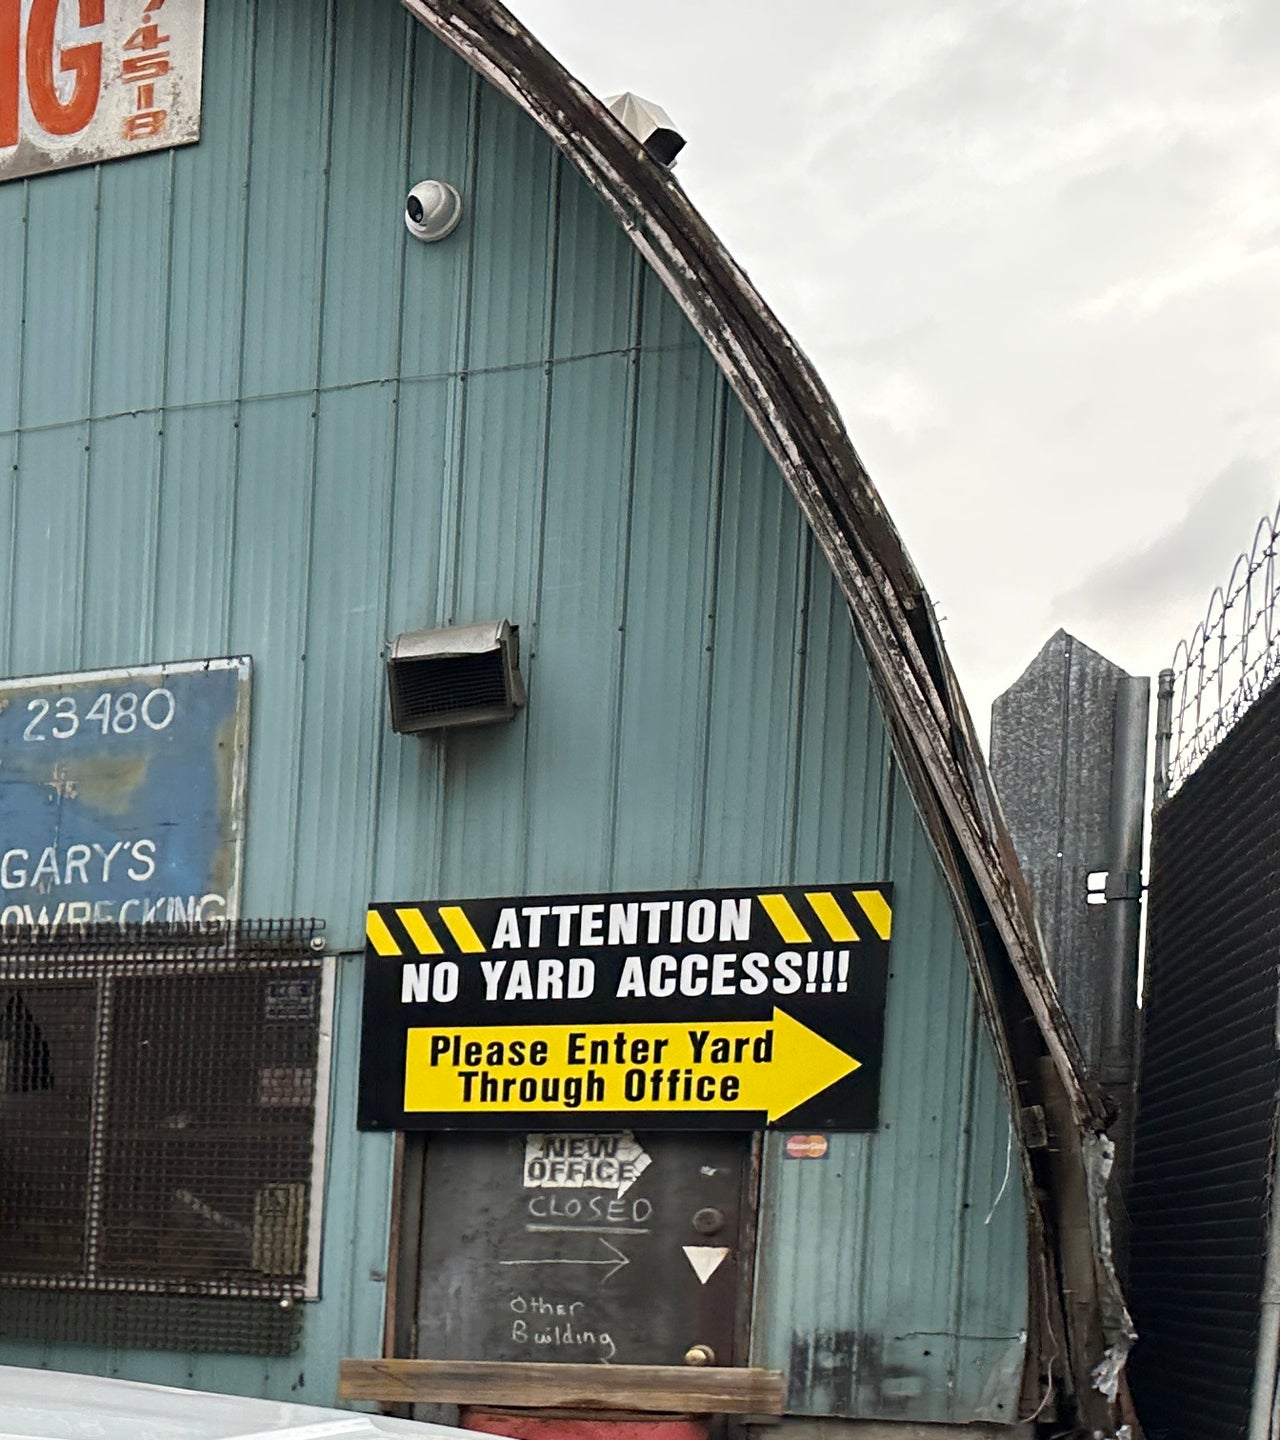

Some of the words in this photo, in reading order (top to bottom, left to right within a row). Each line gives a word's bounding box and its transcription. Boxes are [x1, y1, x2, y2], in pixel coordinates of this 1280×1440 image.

[22, 687, 176, 742] 23480
[0, 839, 157, 890] GARY'S
[491, 897, 752, 949] ATTENTION
[401, 961, 459, 1004] NO
[481, 958, 595, 1001] YARD
[616, 950, 851, 999] ACCESS!!!
[430, 1034, 549, 1068] Please
[567, 1031, 669, 1065] Enter
[688, 1028, 774, 1064] Yard
[457, 1069, 606, 1109] Through
[624, 1067, 740, 1102] Office
[543, 1136, 619, 1158] NEW
[527, 1156, 634, 1181] OFFICE
[528, 1195, 654, 1222] CLOSED
